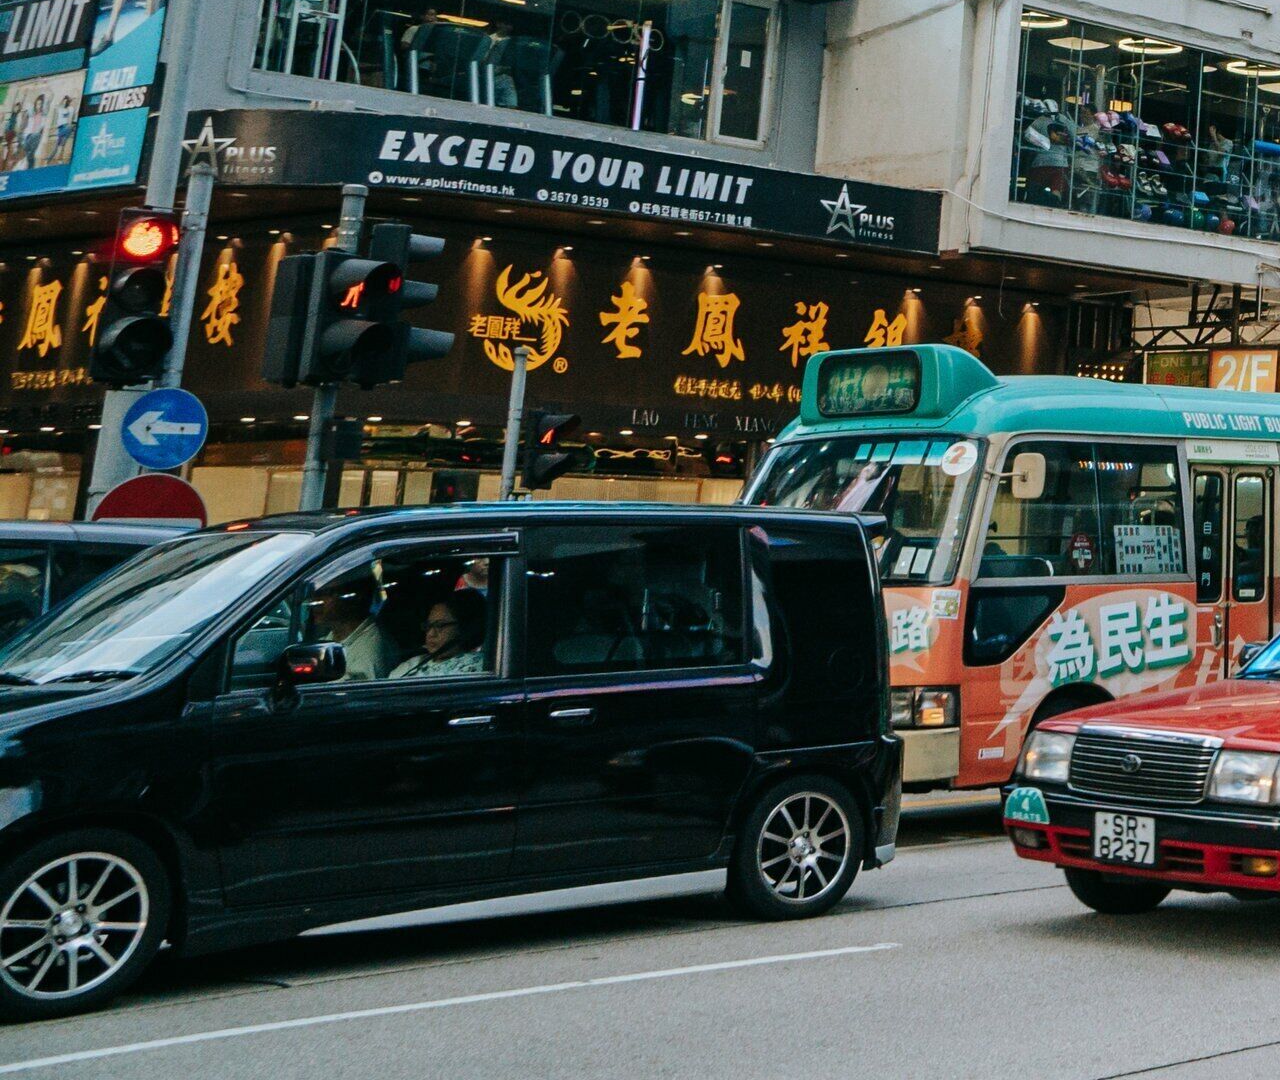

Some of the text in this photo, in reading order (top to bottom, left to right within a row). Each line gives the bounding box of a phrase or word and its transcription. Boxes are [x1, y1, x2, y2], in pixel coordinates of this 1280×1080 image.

[98, 86, 148, 113] FITNESS
[223, 145, 278, 162] PLUS
[222, 163, 275, 175] fitness
[378, 129, 755, 206] EXCEED YOUR LIMIT
[385, 173, 515, 198] www.aplusfitness.hk
[550, 191, 579, 205] 3679
[582, 194, 610, 209] 3539
[859, 212, 896, 231] PLUS
[858, 228, 895, 241] fitness
[1216, 354, 1271, 392] 2/F
[631, 408, 659, 427] LAO
[1182, 411, 1228, 432] PUBLIC
[1228, 414, 1263, 432] LIGHT
[1048, 593, 1193, 687] 為民生
[1021, 797, 1030, 812] 4
[1012, 811, 1041, 822] SEATS
[1113, 815, 1138, 838] SR
[1099, 836, 1150, 863] 8237
